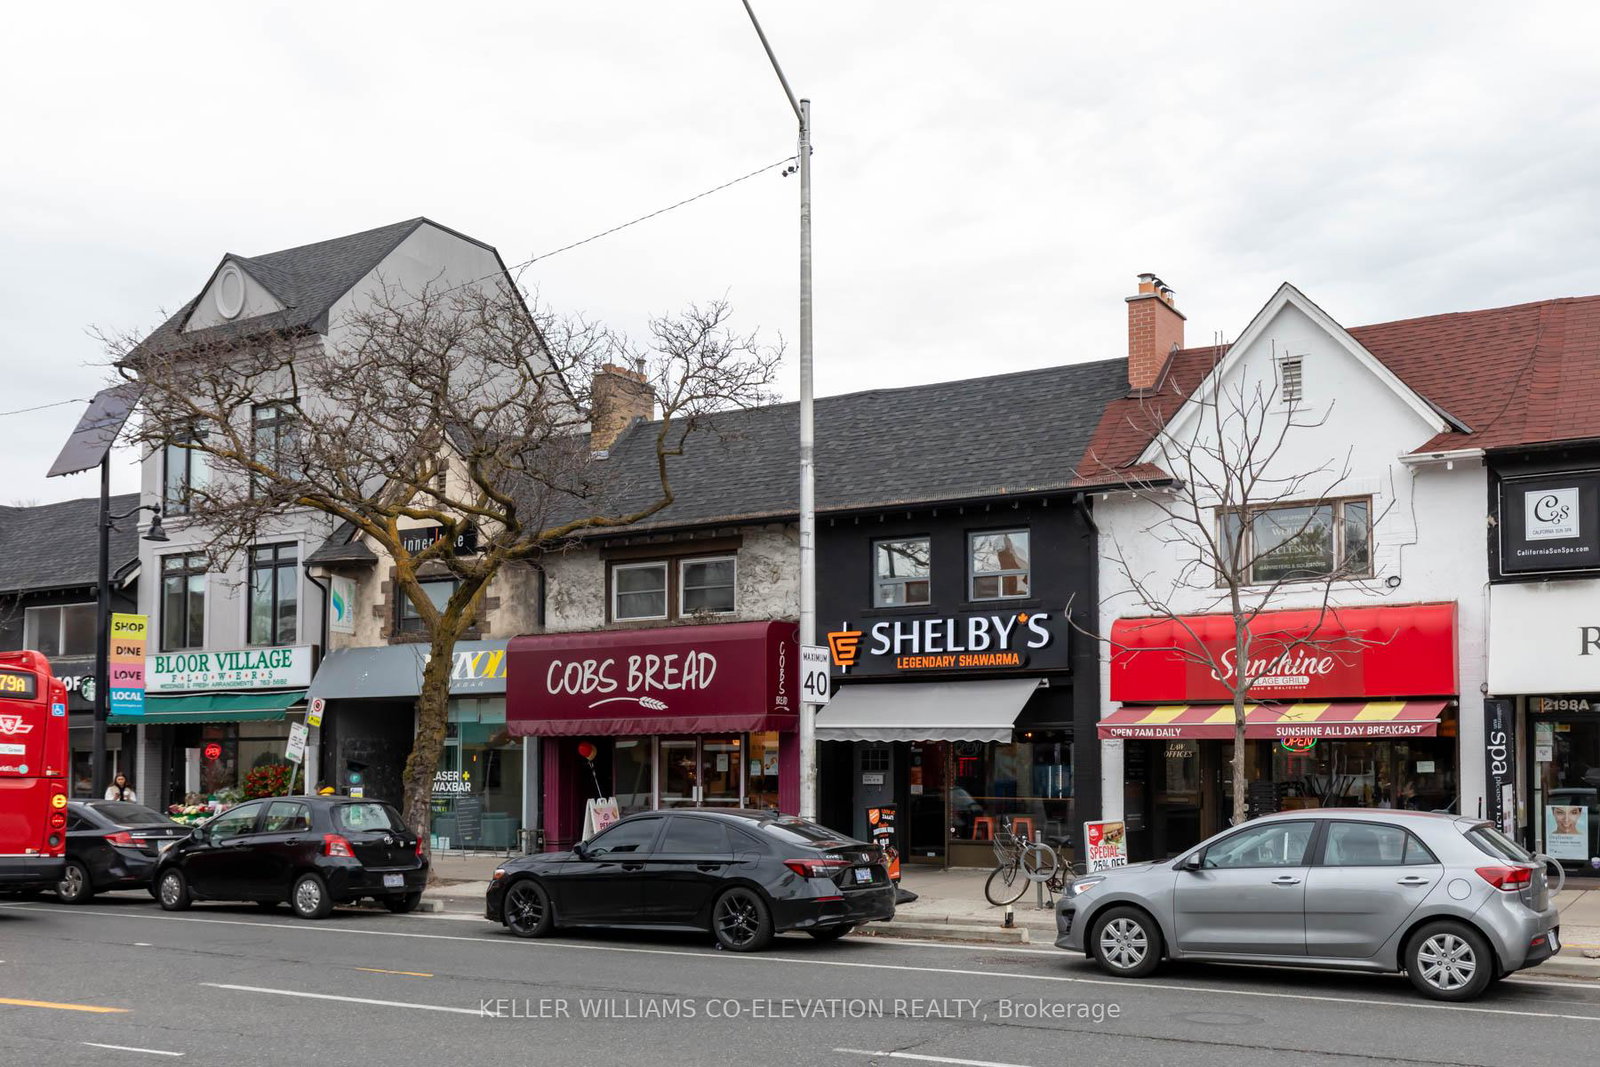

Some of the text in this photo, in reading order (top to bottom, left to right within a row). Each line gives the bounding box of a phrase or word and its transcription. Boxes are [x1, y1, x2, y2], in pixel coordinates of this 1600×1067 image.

[1516, 545, 1590, 557] CaliforniaSunSpa.com
[114, 621, 145, 633] SHOP
[870, 612, 1050, 656] SHELBY'S
[115, 645, 142, 656] DINE
[154, 648, 293, 674] BLOOR VILLAGE
[802, 652, 828, 662] MAXIMUM
[896, 652, 1020, 669] LEGENDARY SHAWARMA
[546, 658, 619, 695] COBS
[626, 650, 718, 693] BREAD
[778, 640, 786, 695] COBS
[113, 670, 142, 680] LOVE
[1281, 676, 1307, 684] GRILL
[211, 680, 254, 688] ARRANGEMENTS
[803, 670, 828, 696] 40
[111, 691, 142, 702] LOCAL
[1543, 699, 1590, 712] 2198A
[1110, 727, 1182, 737] OPEN 7AM DAILY
[1276, 724, 1423, 737] SUNSHINE ALL DAY BREAKFAST
[1169, 743, 1186, 751] LAW
[1283, 737, 1314, 747] OPEN
[1163, 751, 1193, 759] OFFICES
[1487, 731, 1508, 775] spa
[1089, 845, 1120, 860] SPECIAL
